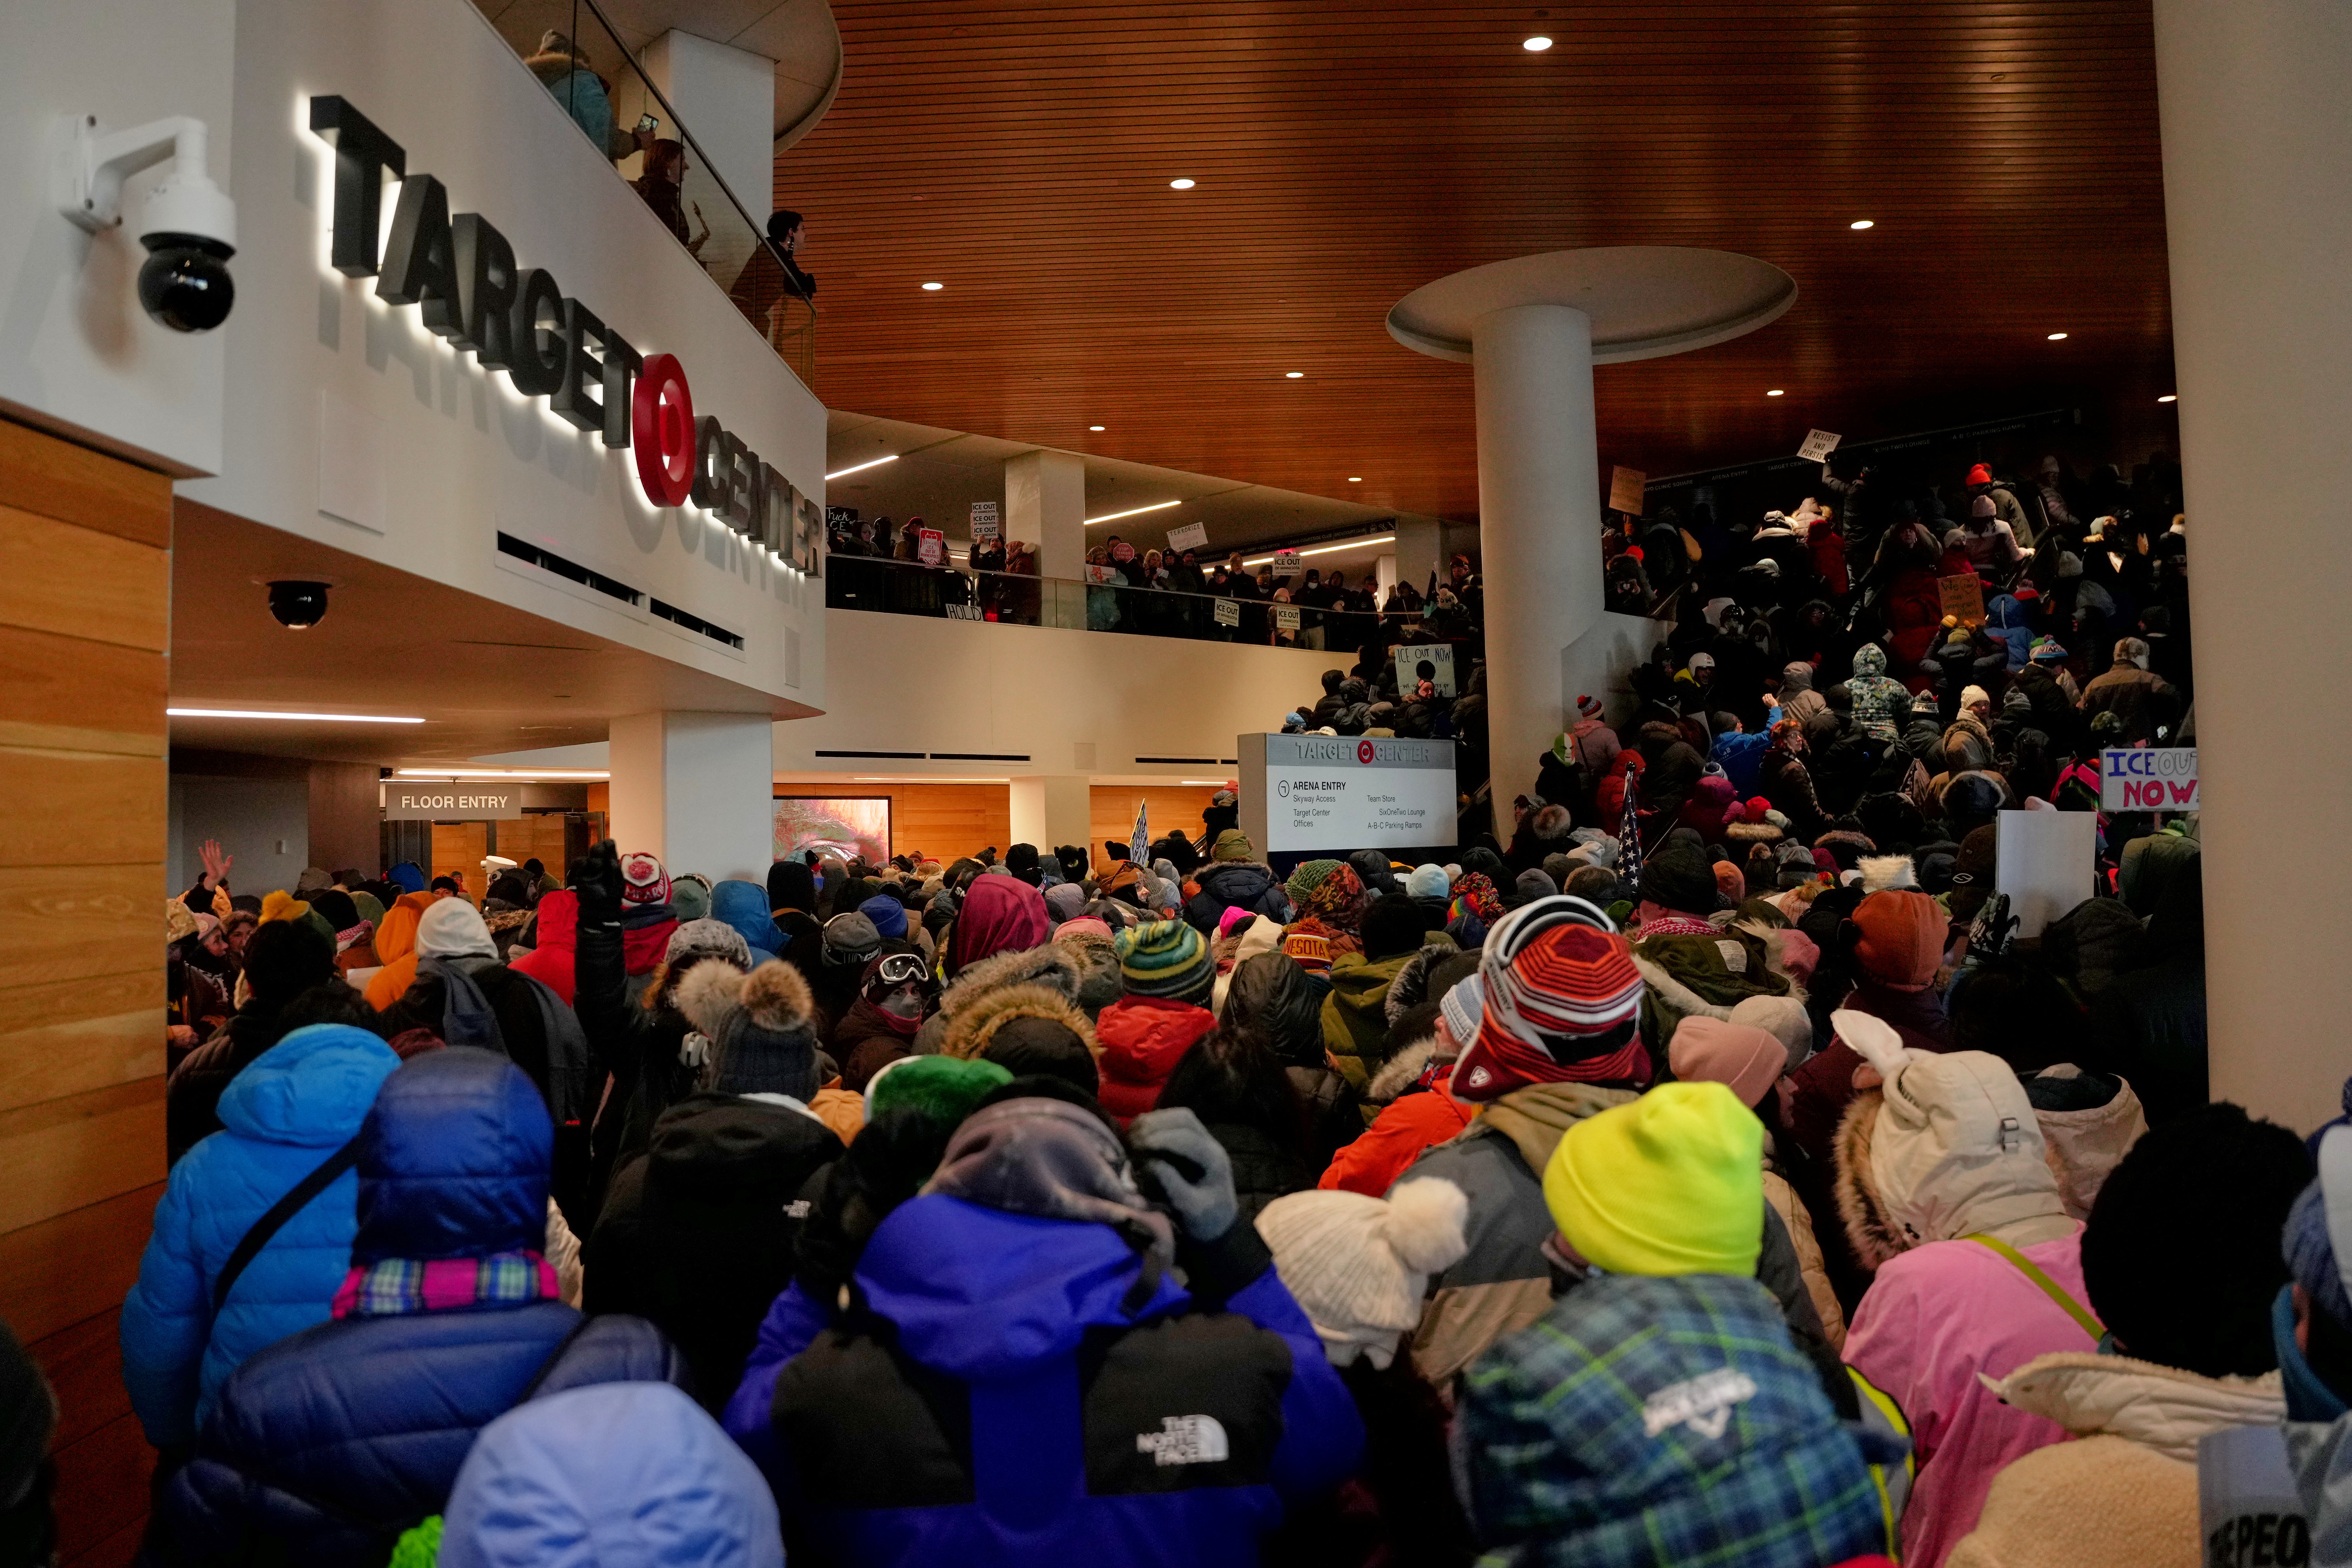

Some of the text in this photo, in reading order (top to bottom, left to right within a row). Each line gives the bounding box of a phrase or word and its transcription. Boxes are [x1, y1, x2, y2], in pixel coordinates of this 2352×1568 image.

[310, 95, 823, 579] TARGET CENTER
[1812, 432, 1835, 442] RESIST
[1973, 427, 2001, 436] PARKING
[1813, 442, 1825, 450] AND
[1905, 438, 1931, 448] LOUNGE
[1801, 449, 1825, 461] PERSIS
[1767, 463, 1789, 471] TARGET
[1790, 459, 1812, 467] CENTER
[1731, 470, 1748, 478] ENTRY
[1673, 479, 1693, 487] SQUARE
[826, 507, 850, 521] Fuck
[830, 521, 846, 530] CE
[1169, 523, 1201, 536] TERRORIZE
[948, 605, 981, 621] HOLD
[1216, 603, 1225, 612] ICE
[1227, 607, 1238, 616] OUT
[1398, 647, 1451, 663] ICE OUT NOW
[1295, 741, 1430, 762] TARGET CENTER
[2106, 751, 2197, 777] ICE OU
[1293, 781, 1346, 791] ARENA ENTRY
[1293, 795, 1315, 804] Skyway
[2123, 779, 2199, 808] NOW
[401, 795, 508, 809] FLOOR ENTRY
[1293, 809, 1311, 817] Target
[1379, 808, 1426, 817] SixOneTwo Lounge
[1293, 819, 1313, 827] Offices
[1367, 822, 1422, 830] A-B-C Parking Ramps
[1286, 939, 1326, 957] NESOTA
[1161, 1415, 1197, 1432] THE
[1136, 1426, 1198, 1453] NORTH
[1155, 1443, 1199, 1467] FACE
[2238, 1514, 2310, 1568] PEO
